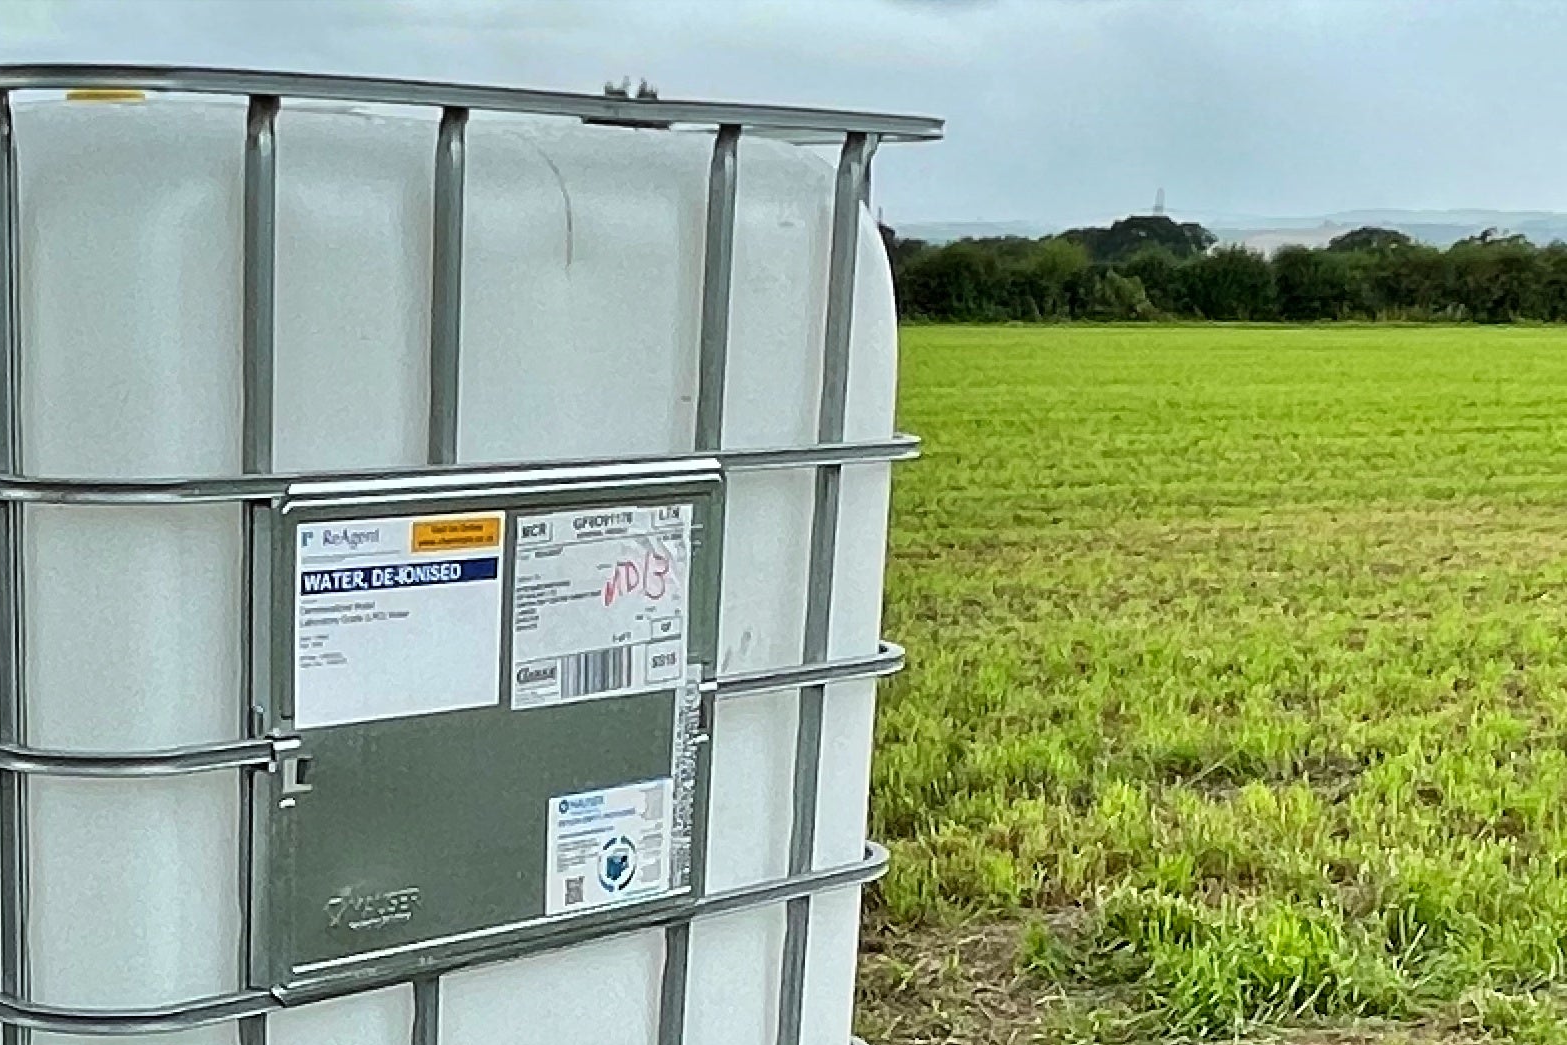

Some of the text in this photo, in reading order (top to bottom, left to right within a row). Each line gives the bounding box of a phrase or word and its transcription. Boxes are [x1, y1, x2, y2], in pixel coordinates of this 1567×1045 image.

[322, 528, 380, 549] ReAgent
[303, 563, 462, 592] WATER, DE-IONISED
